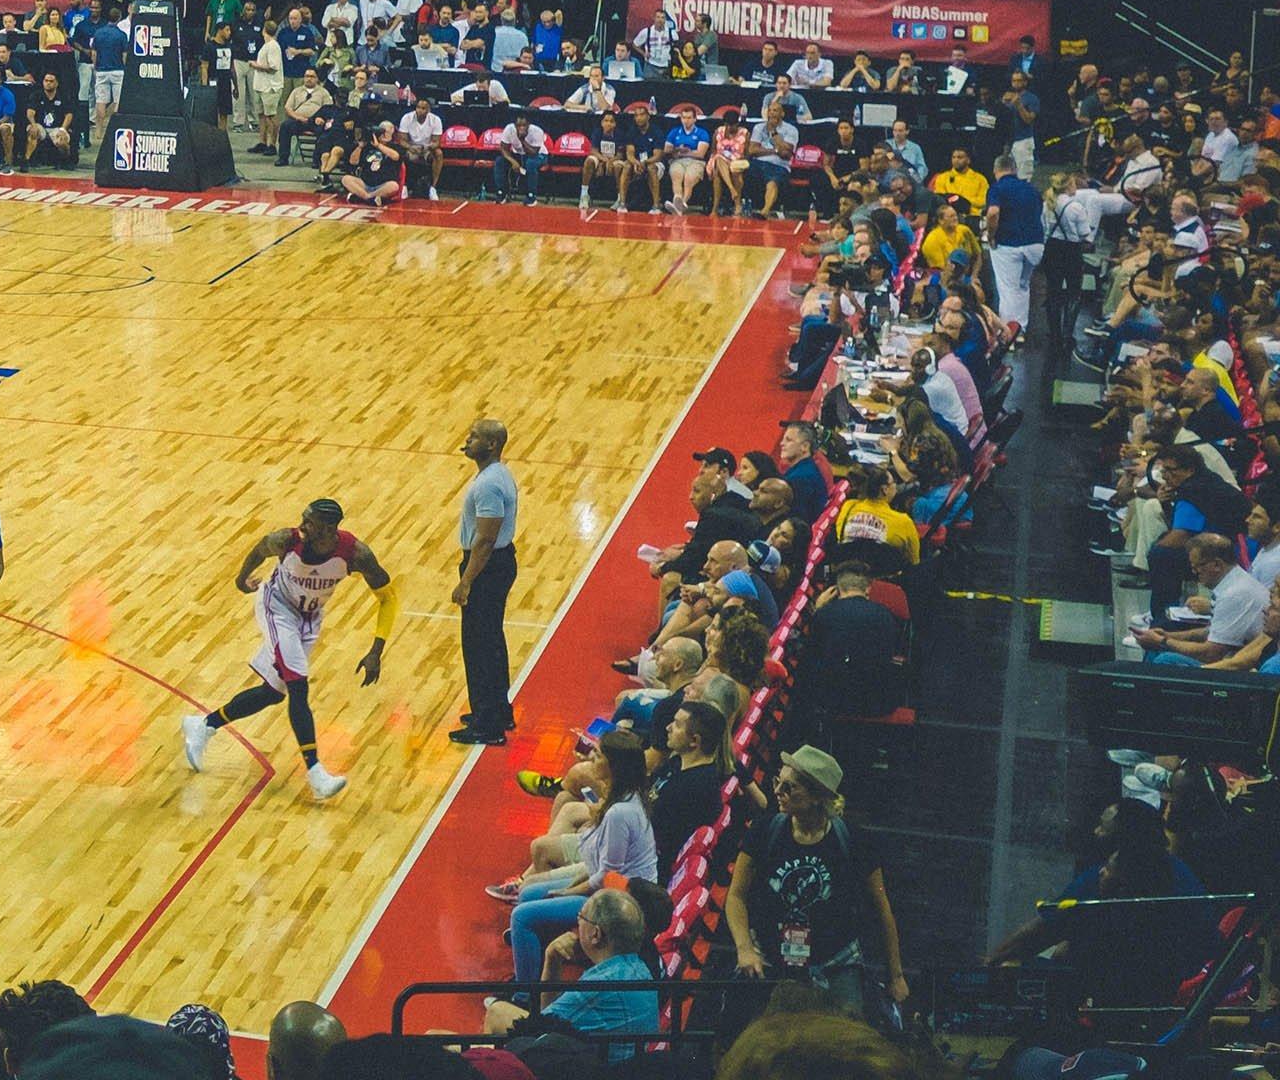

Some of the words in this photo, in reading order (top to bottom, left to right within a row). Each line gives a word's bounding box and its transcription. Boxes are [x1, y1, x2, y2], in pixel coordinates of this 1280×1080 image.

[765, 3, 833, 41] LEAGUE
[891, 5, 989, 23] #NBASummer
[139, 62, 164, 80] @NBA
[135, 134, 177, 156] SUMMER
[134, 153, 170, 173] LEAGUE
[169, 197, 386, 225] LEAGUE
